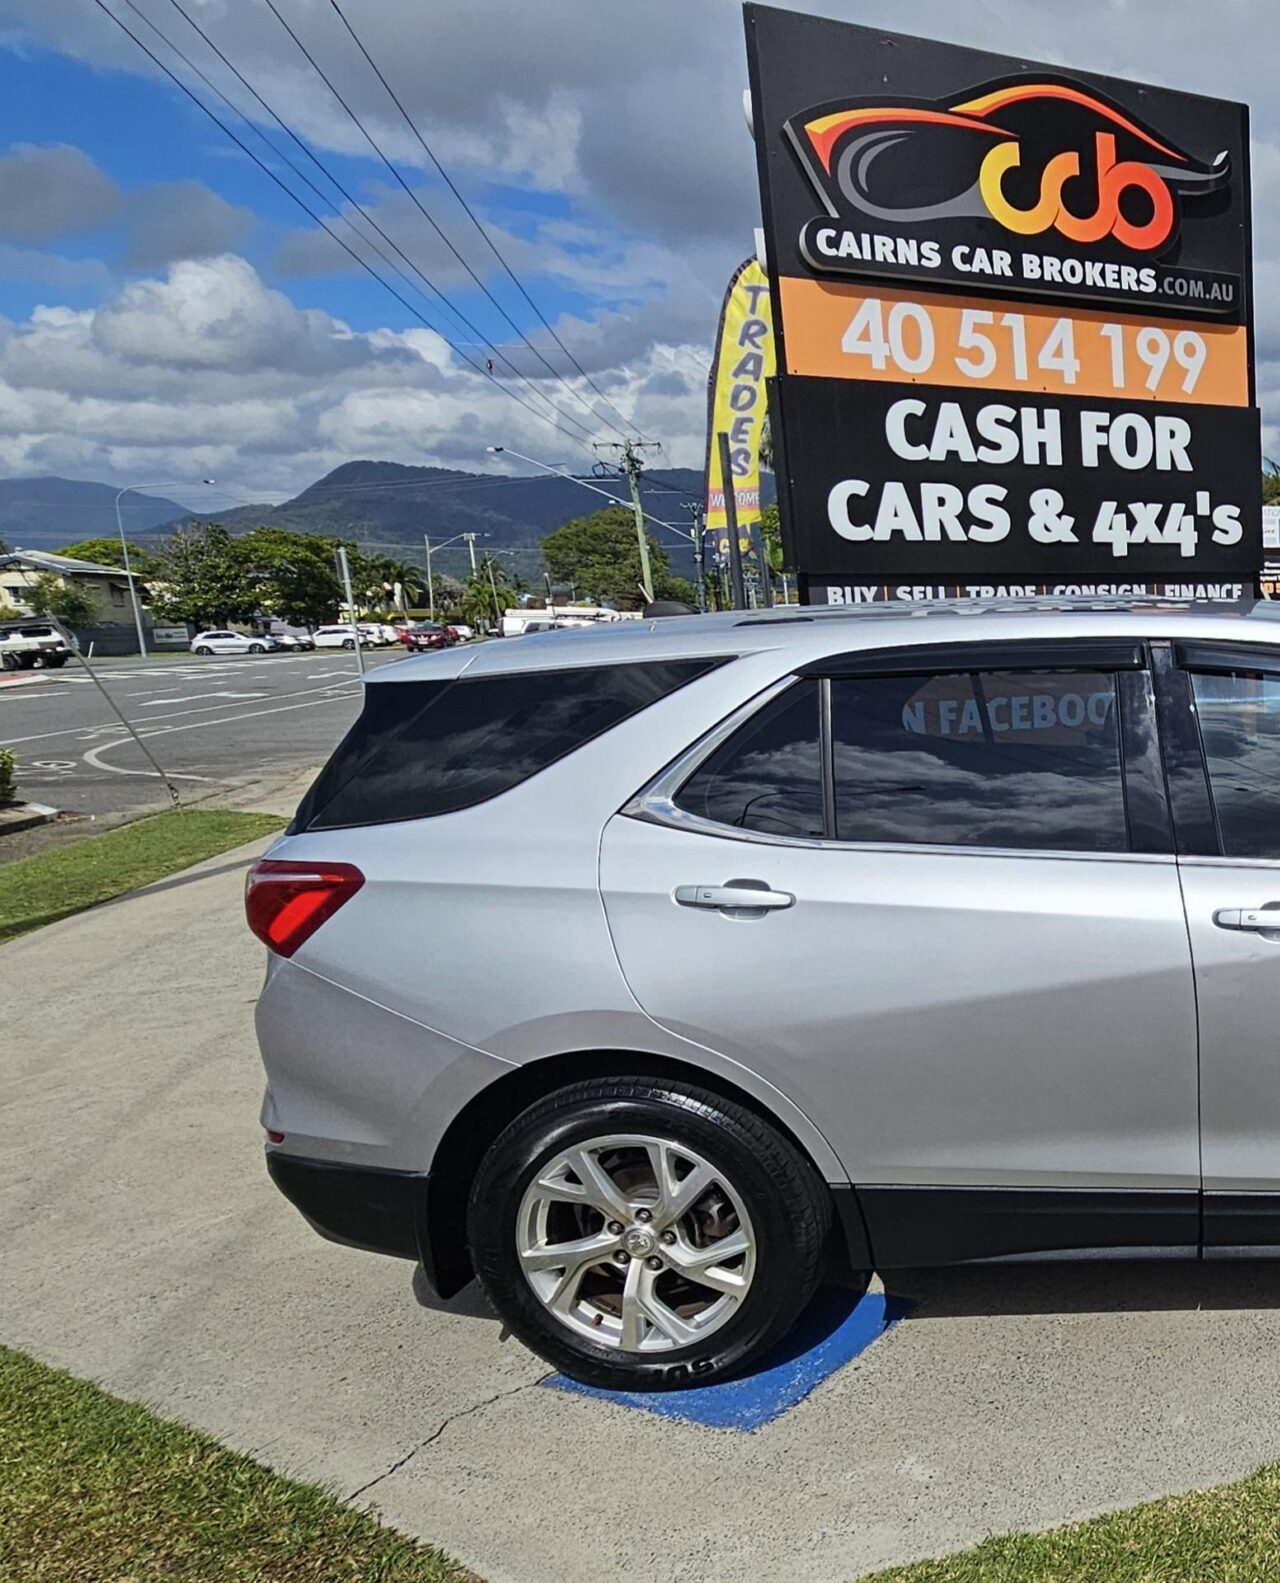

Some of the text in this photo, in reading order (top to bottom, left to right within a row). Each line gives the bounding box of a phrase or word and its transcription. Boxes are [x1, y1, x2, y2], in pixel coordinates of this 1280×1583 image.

[816, 228, 942, 268] CAIRNS
[951, 245, 1013, 278] CAR
[841, 298, 1207, 395] 40 514 199
[728, 285, 769, 477] TRADES
[885, 399, 1194, 472] CASH FOR
[827, 479, 1012, 543] CARS
[1027, 488, 1079, 544] &
[826, 586, 878, 605] BUY
[939, 692, 1111, 736] FACEBOO
